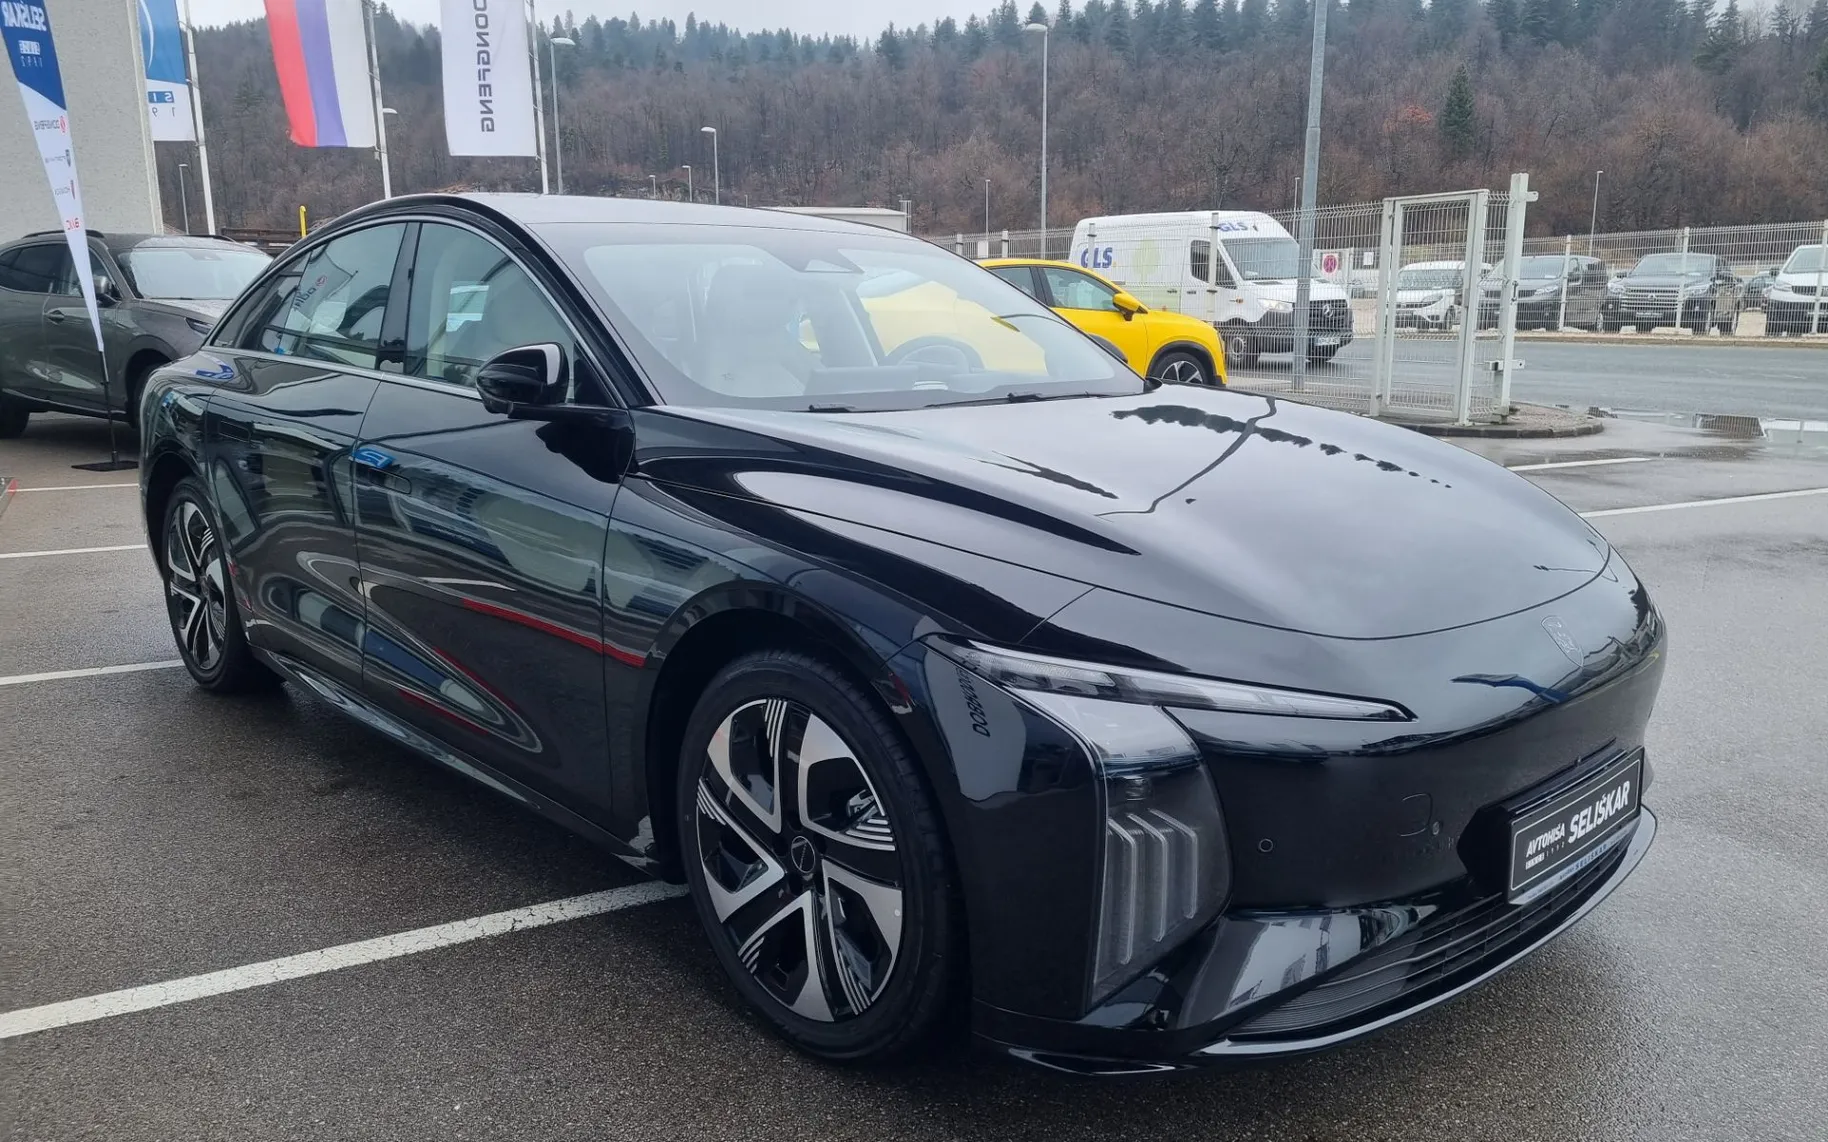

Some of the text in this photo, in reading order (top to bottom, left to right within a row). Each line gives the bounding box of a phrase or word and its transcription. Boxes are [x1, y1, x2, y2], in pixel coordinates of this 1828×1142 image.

[1219, 222, 1248, 232] GLS
[1526, 781, 1631, 858] AVTOHIŠA SELIŠKAR
